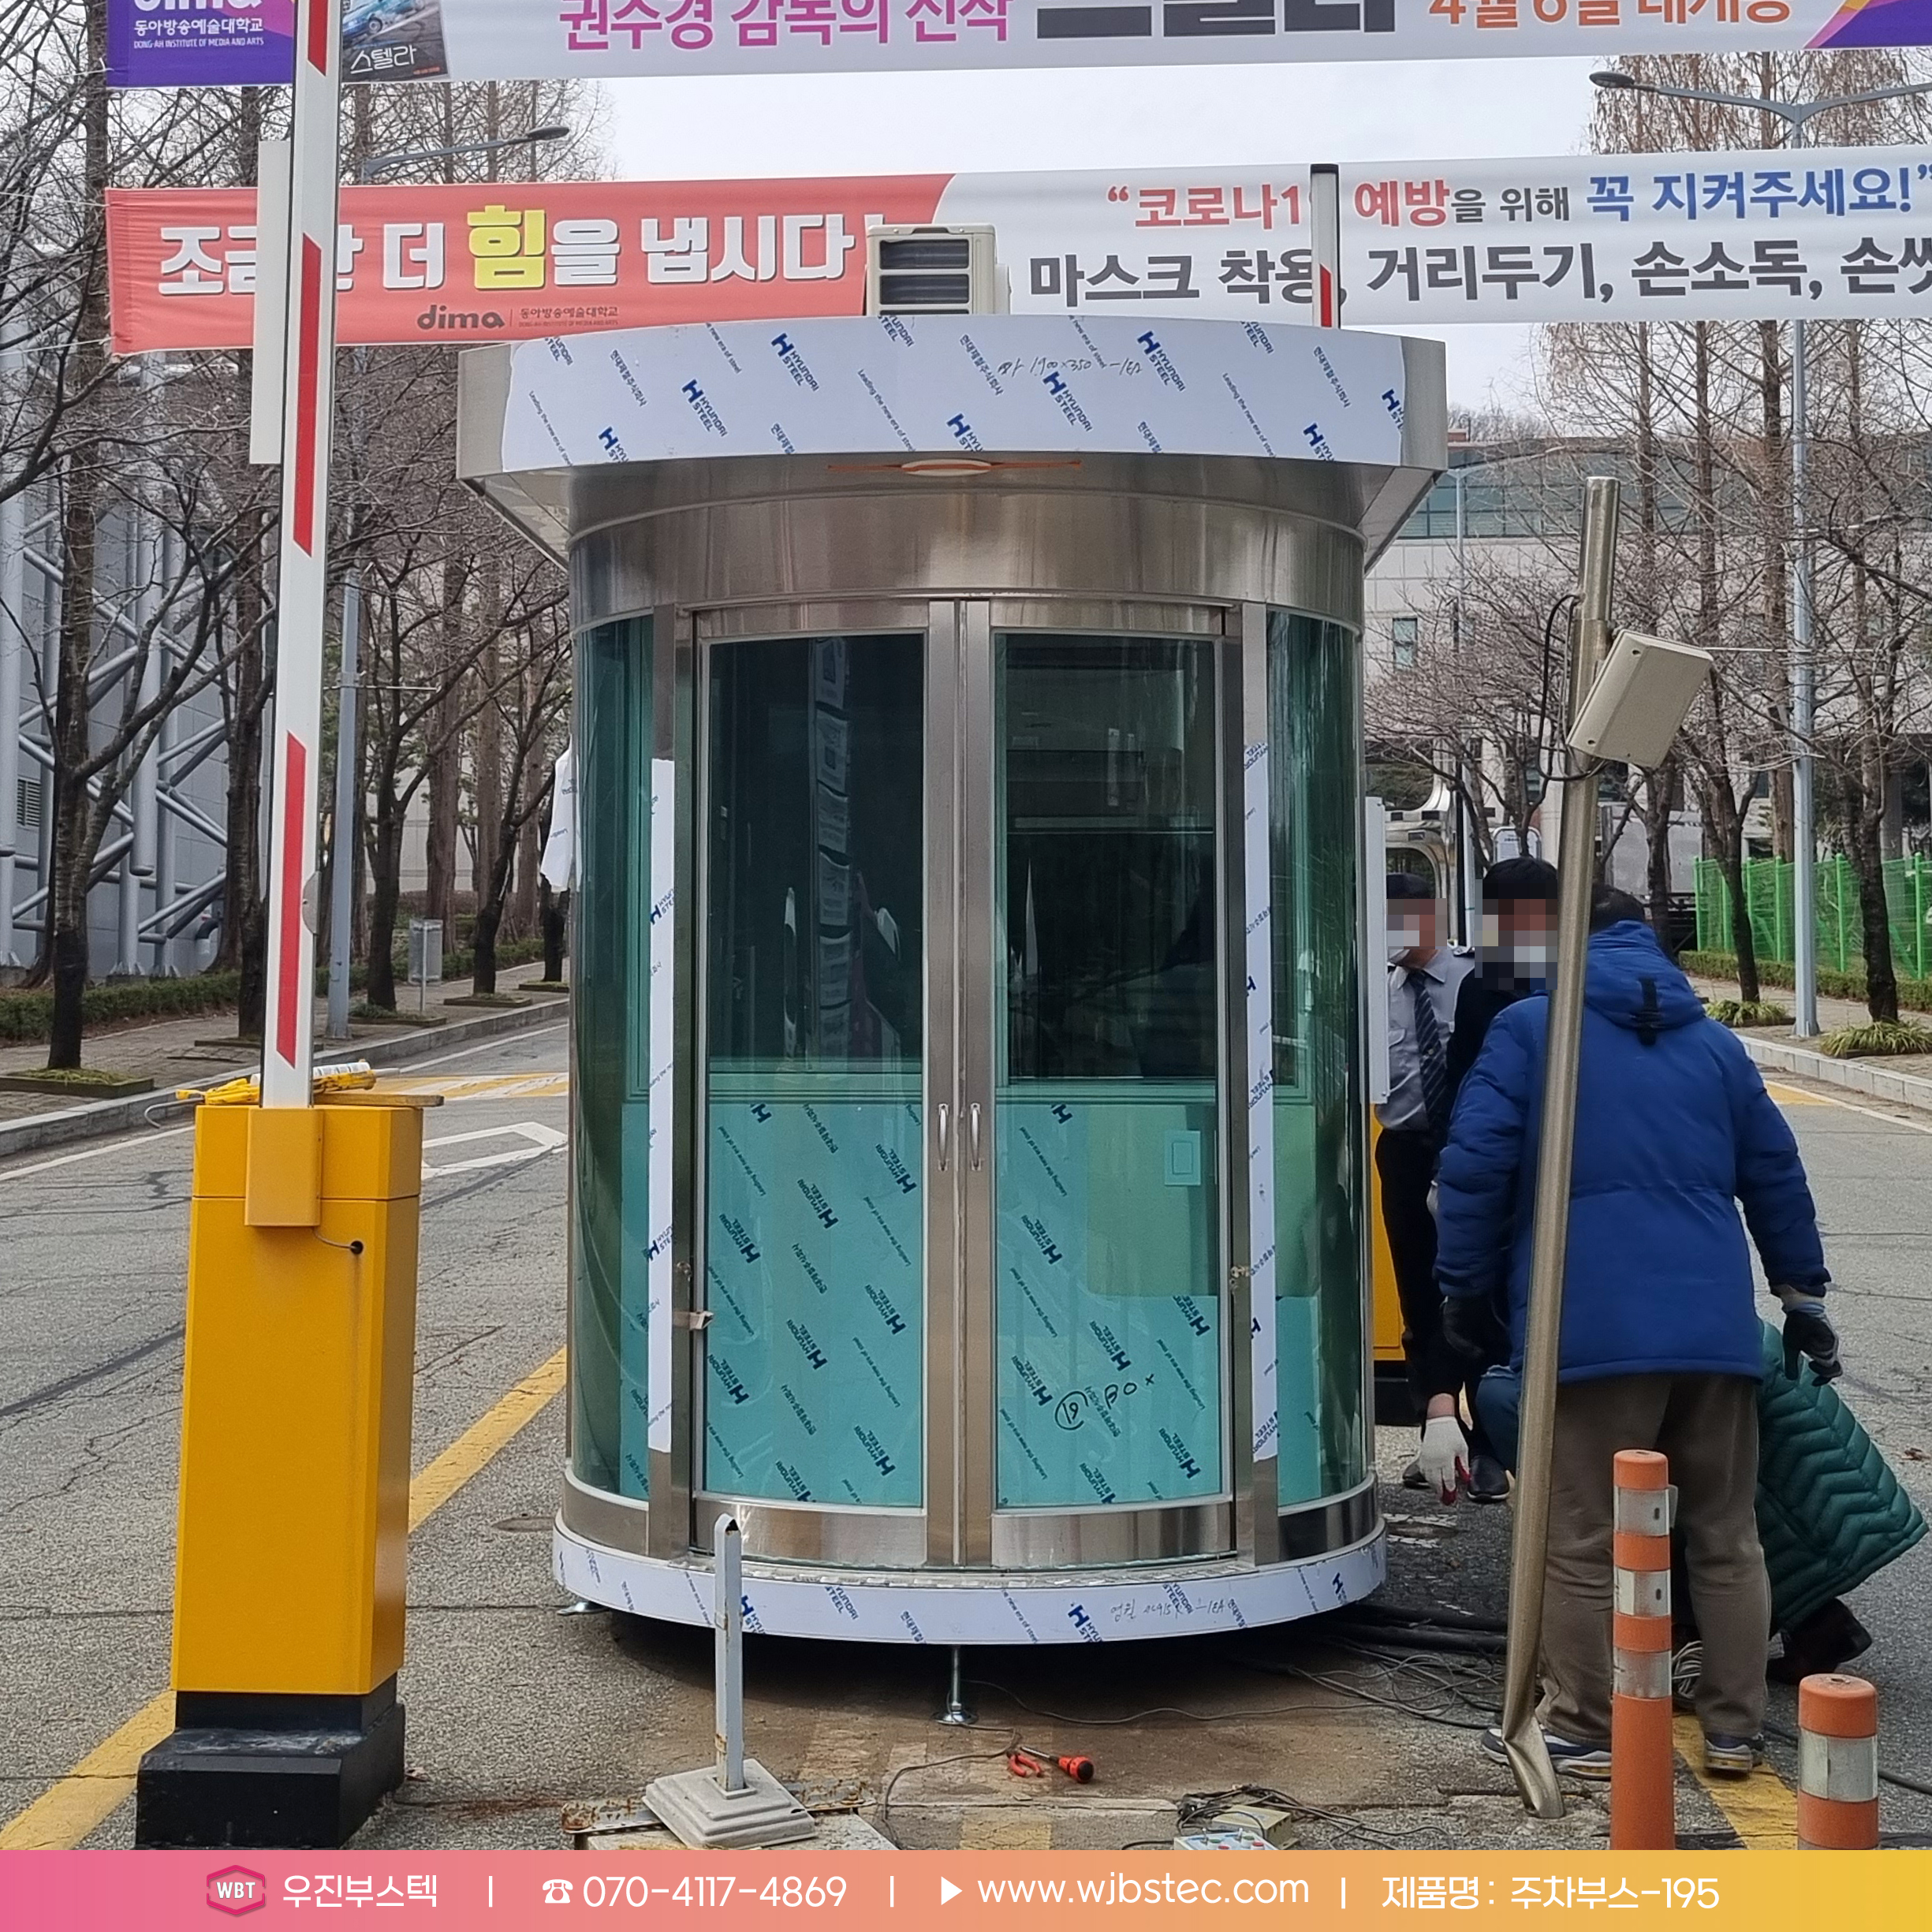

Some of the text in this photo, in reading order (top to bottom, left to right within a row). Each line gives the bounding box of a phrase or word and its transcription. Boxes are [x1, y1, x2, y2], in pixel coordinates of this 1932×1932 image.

[134, 17, 263, 36] 동아방송예술대학교
[208, 38, 230, 47] MEDIA
[247, 37, 264, 46] ARTS
[350, 44, 417, 74] 스텔라
[1353, 179, 1486, 228] 예방을
[1500, 186, 1569, 222] 위해
[1587, 175, 1634, 222] 꼭
[383, 222, 445, 289] 더
[468, 204, 621, 290] 힘을
[1030, 254, 1199, 307] 마스크
[1367, 242, 1613, 304] 거리두기,
[1631, 239, 1822, 300] 손소독,
[417, 304, 505, 330] dima
[521, 306, 618, 319] 동아방송예술대학교
